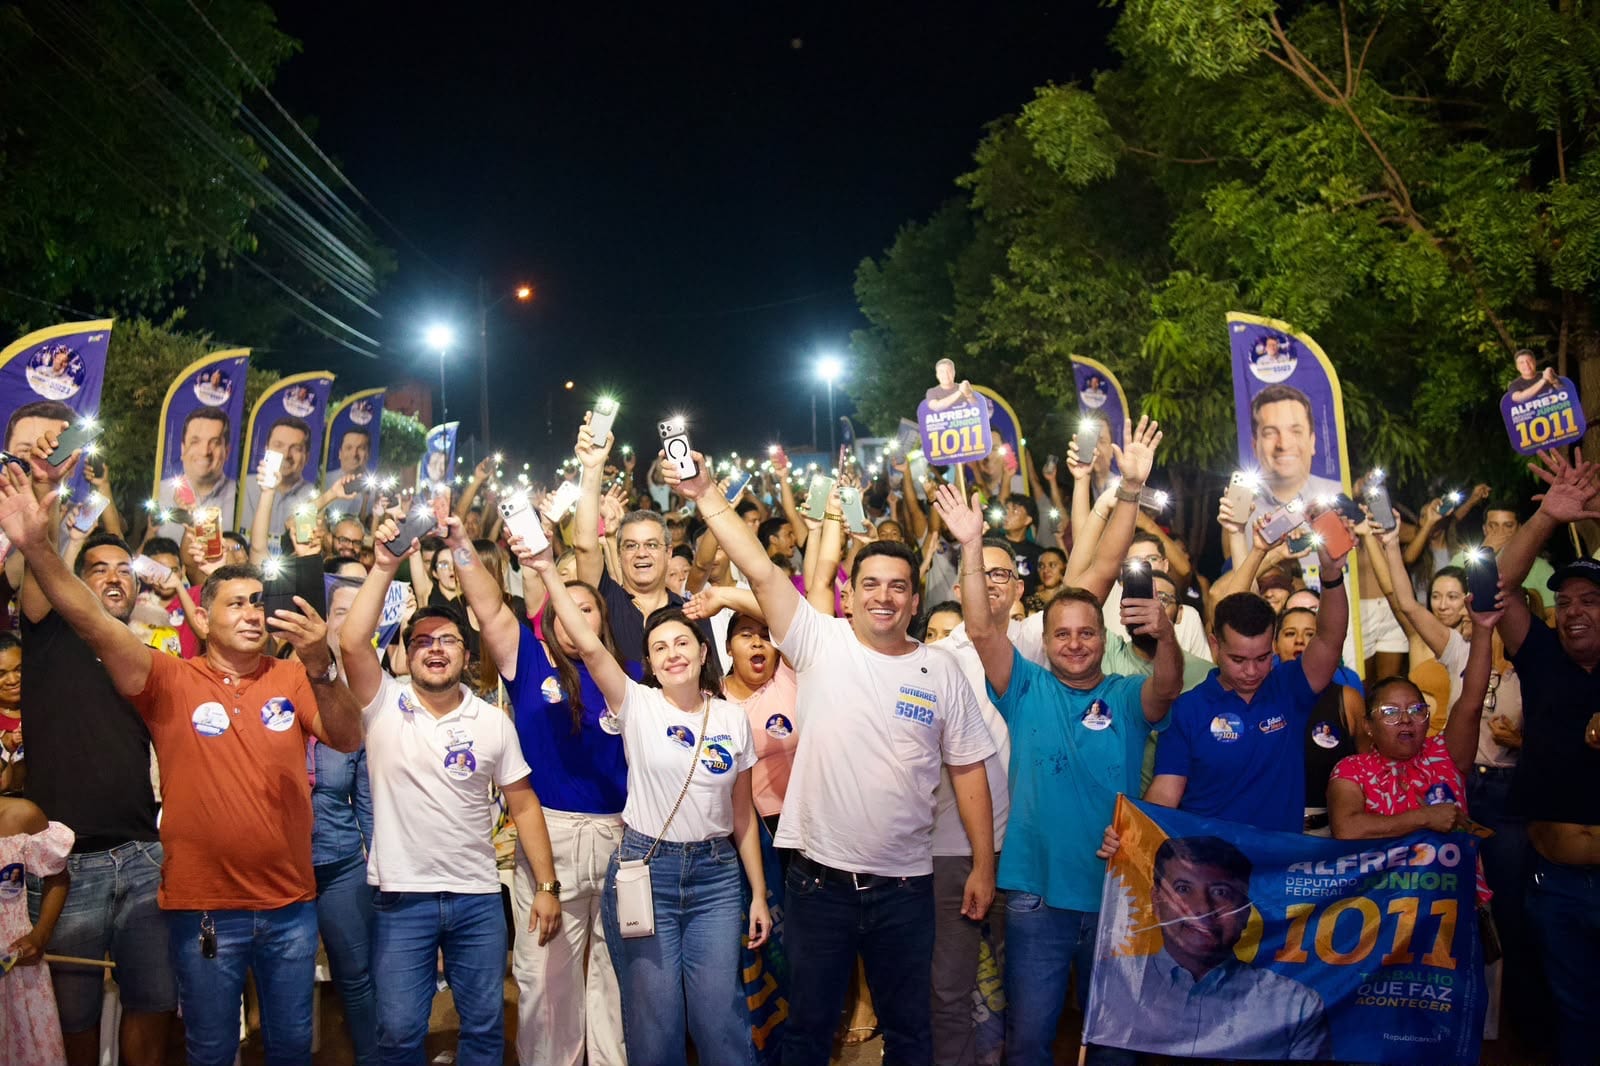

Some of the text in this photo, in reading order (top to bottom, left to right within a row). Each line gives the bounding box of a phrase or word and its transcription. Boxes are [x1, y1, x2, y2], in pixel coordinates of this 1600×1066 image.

[1511, 391, 1568, 416] ALFREDO
[926, 407, 980, 424] ALFREDO
[1516, 407, 1578, 448] 1011
[928, 425, 985, 457] 1011
[899, 686, 937, 703] GUTIERRES
[895, 701, 934, 725] 55123
[1287, 843, 1461, 875] ALFREDO
[1285, 876, 1357, 888] DEPUTADO
[1285, 886, 1345, 897] FEDERAL
[1273, 896, 1458, 970] 1011
[1357, 981, 1453, 1002] QUE FAZ
[1355, 996, 1452, 1013] ACONTECER
